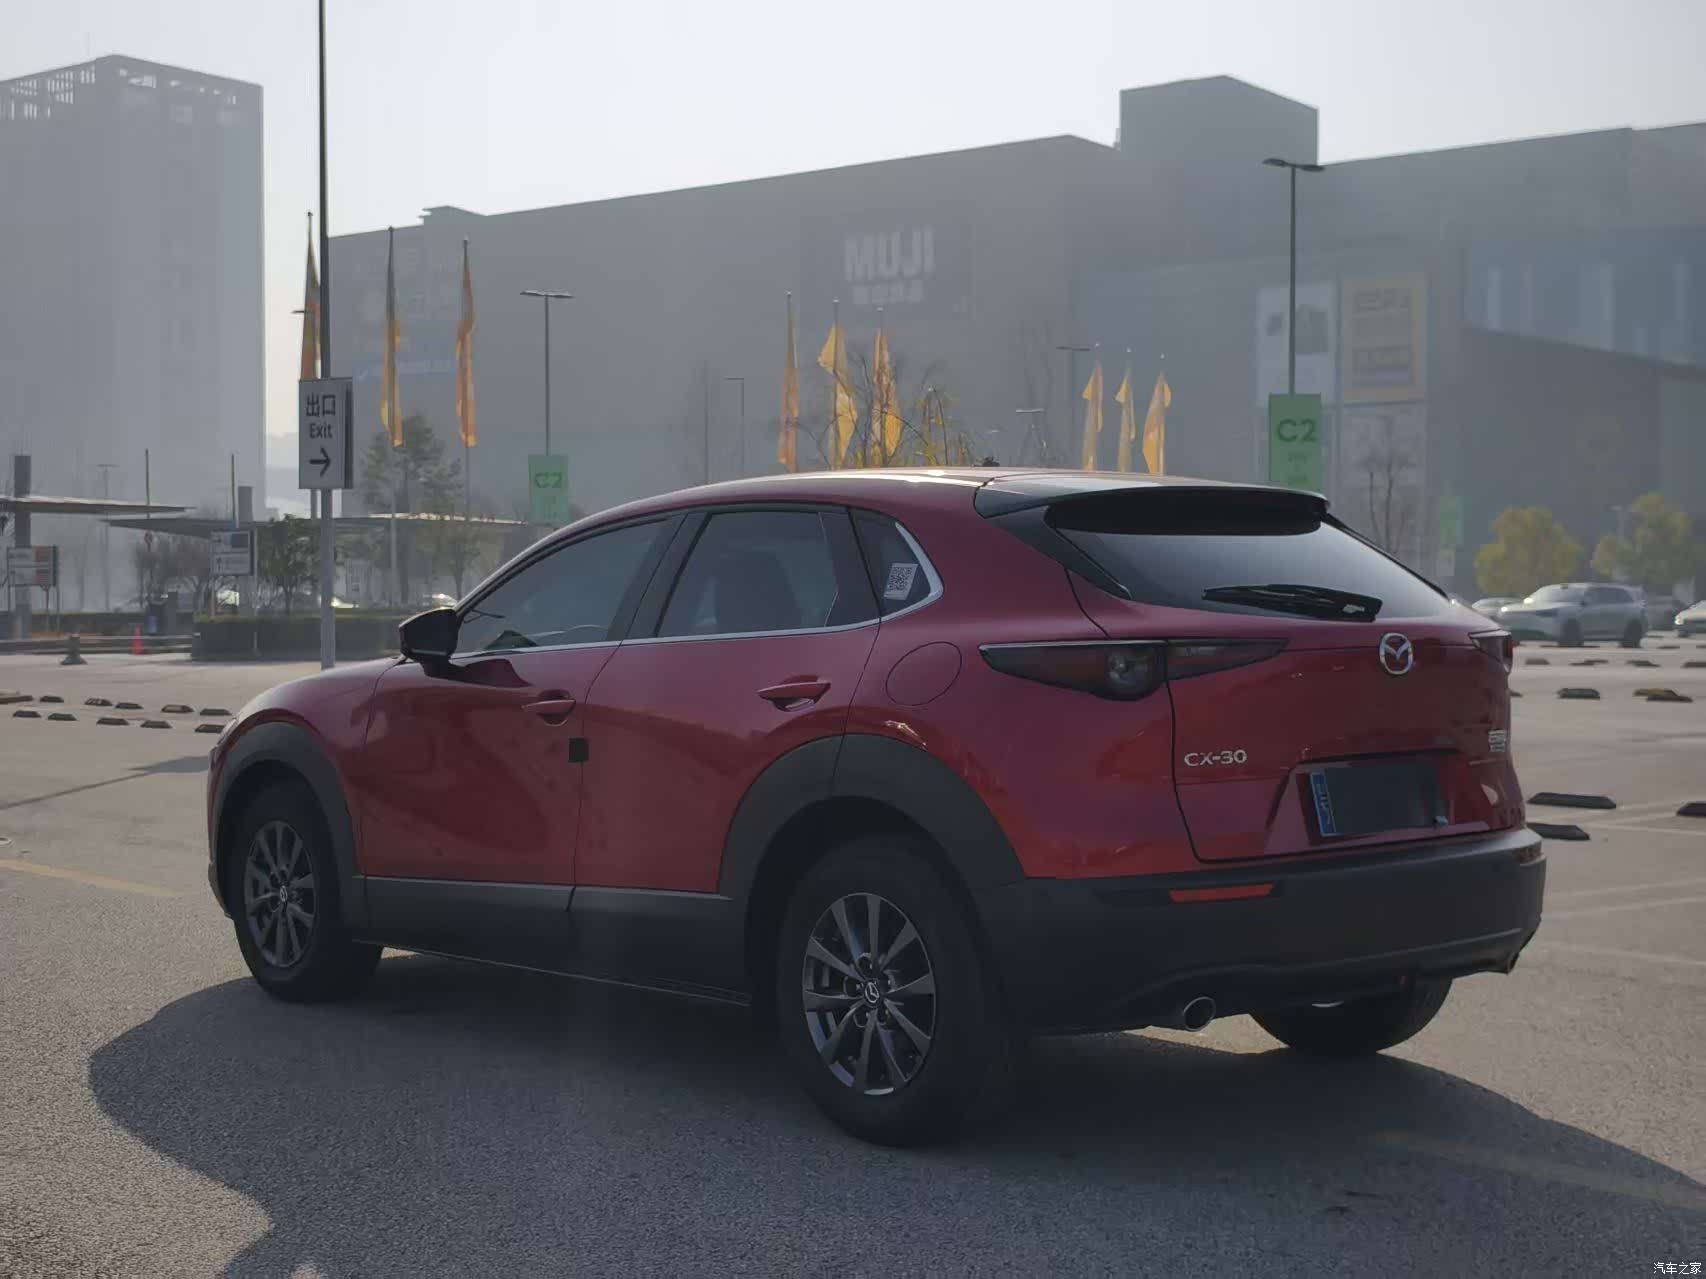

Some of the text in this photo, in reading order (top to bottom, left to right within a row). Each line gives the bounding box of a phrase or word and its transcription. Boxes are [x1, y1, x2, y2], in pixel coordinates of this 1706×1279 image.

[845, 226, 934, 280] MUJI
[306, 392, 336, 417] 出口
[310, 422, 333, 439] Exit
[1277, 418, 1317, 442] C2
[1184, 749, 1247, 767] CX-30
